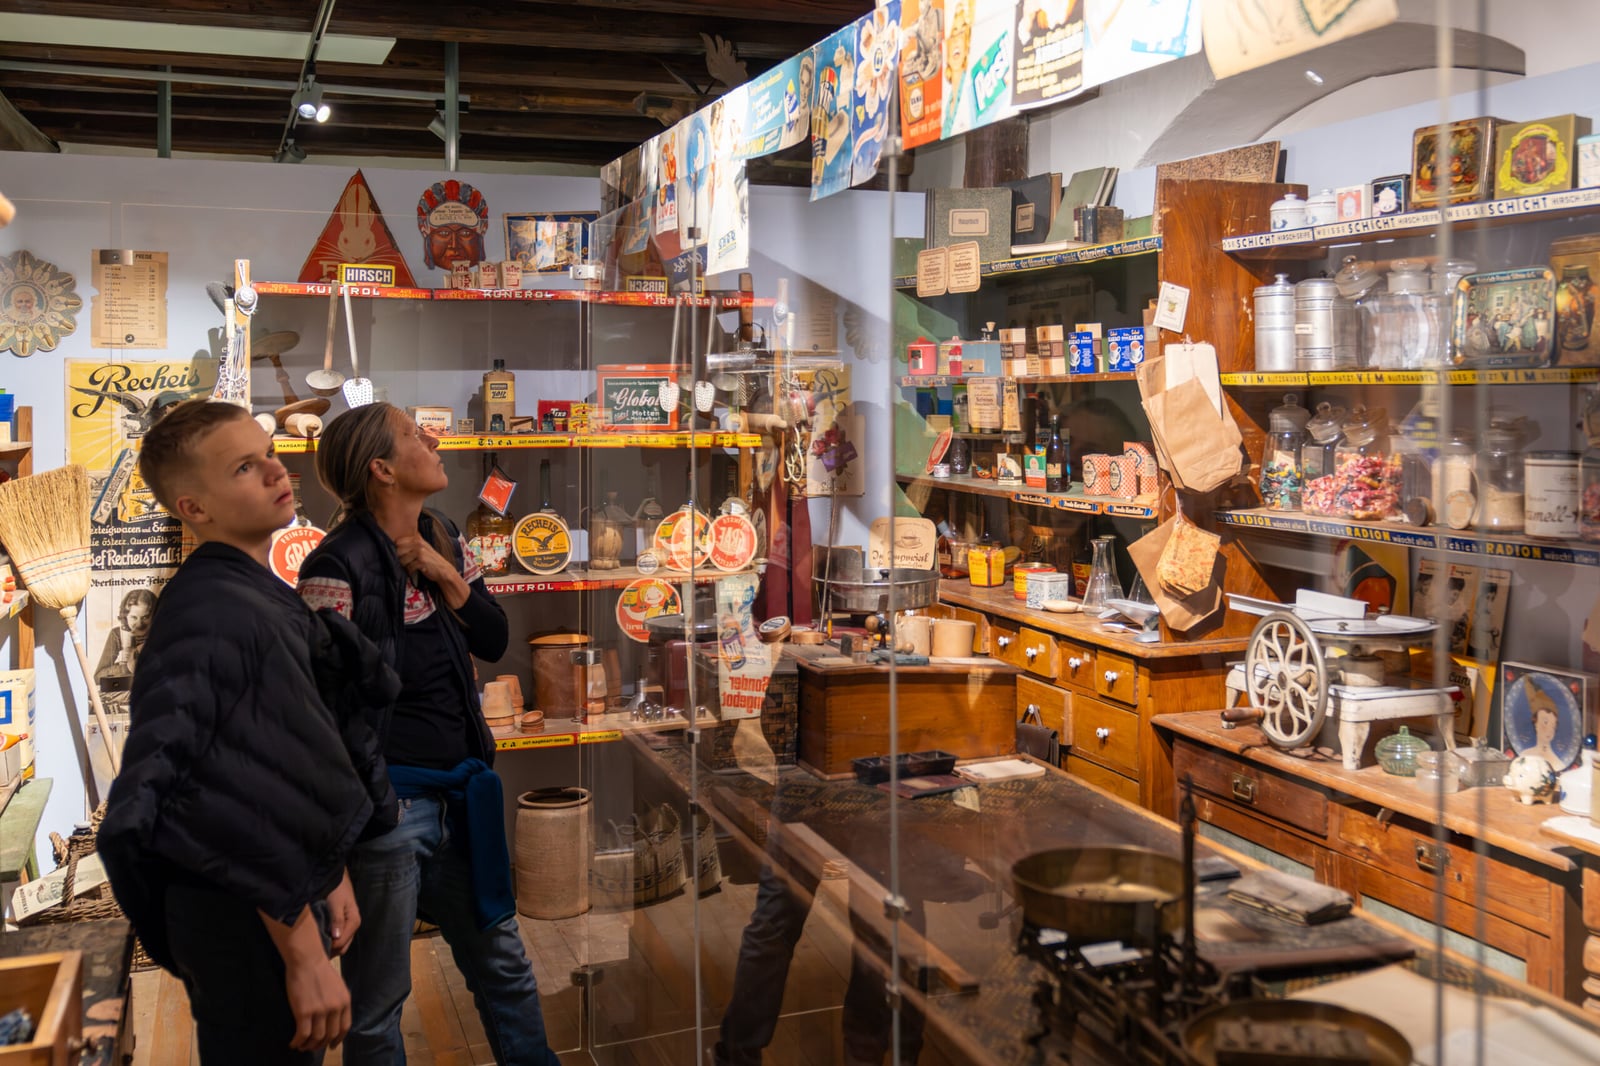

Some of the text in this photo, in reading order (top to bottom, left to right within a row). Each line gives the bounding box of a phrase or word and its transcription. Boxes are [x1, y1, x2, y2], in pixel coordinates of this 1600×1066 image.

[1488, 196, 1547, 215] SCHICHT
[1349, 217, 1395, 234] SCHICHT
[1236, 235, 1275, 248] SCHICHT
[346, 268, 392, 283] HIRSCH
[483, 290, 554, 299] KUNEROL
[1242, 375, 1265, 383] VIM
[1357, 373, 1385, 383] VIM
[1502, 370, 1536, 381] VIM
[72, 364, 200, 418] Recheis
[520, 519, 559, 536] RECHEIS
[1232, 514, 1272, 527] RADION
[280, 529, 314, 544] FEINSTE
[1345, 526, 1391, 541] RADION
[91, 537, 99, 546] ie
[1485, 542, 1542, 559] RADION
[90, 549, 107, 569] sef
[486, 583, 554, 593] KUNEROL
